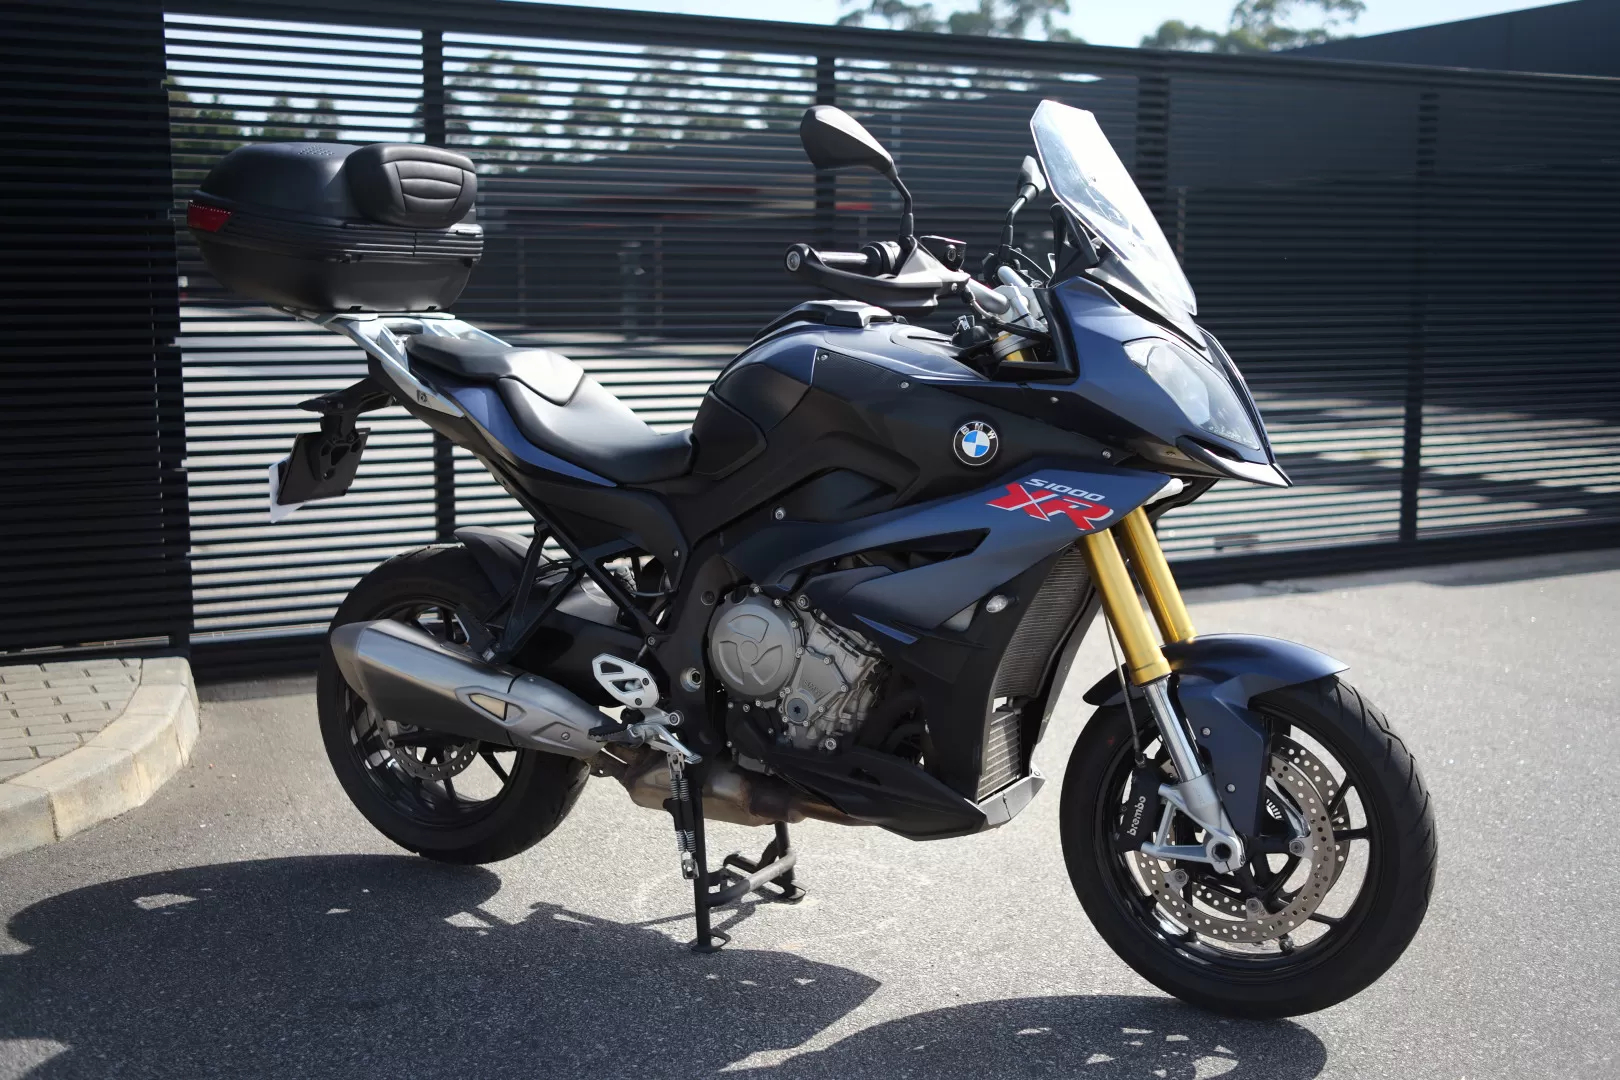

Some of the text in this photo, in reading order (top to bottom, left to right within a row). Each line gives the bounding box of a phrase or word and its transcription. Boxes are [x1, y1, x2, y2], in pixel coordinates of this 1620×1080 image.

[960, 423, 996, 440] BMW
[985, 482, 1114, 531] XR
[1126, 796, 1147, 836] brembo
